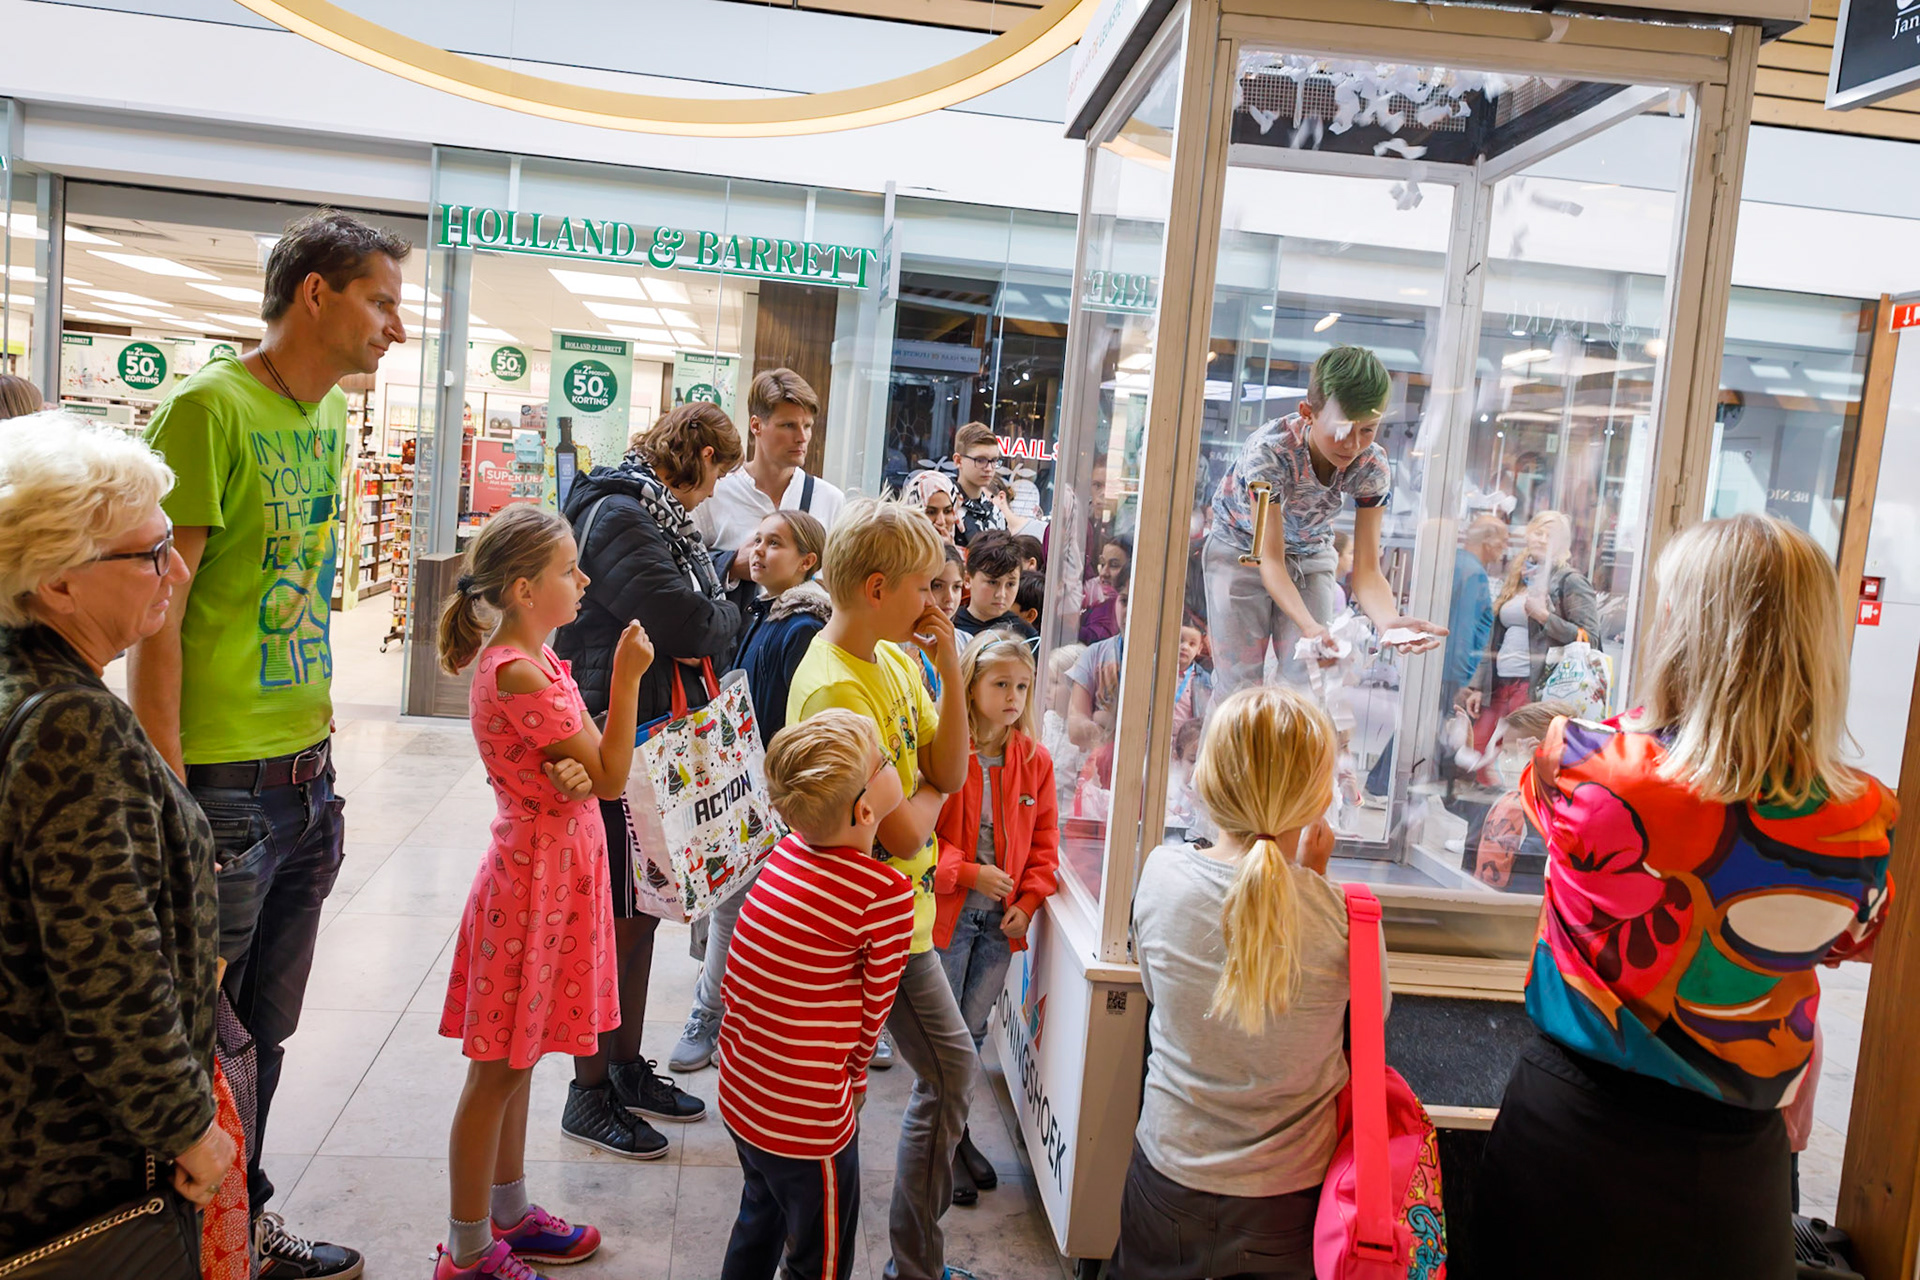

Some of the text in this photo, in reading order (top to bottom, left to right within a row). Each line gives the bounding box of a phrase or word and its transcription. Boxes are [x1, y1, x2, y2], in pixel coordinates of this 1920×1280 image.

[437, 203, 637, 257] HOLLAND
[648, 226, 685, 270] &
[694, 230, 878, 290] BARRETT
[564, 341, 591, 349] HOLLAND
[598, 345, 622, 354] BARRETT
[125, 374, 160, 385] KORTING
[572, 374, 609, 398] 50%
[572, 395, 609, 407] KORTING
[260, 467, 312, 497] YOU
[694, 770, 752, 826] ACTION
